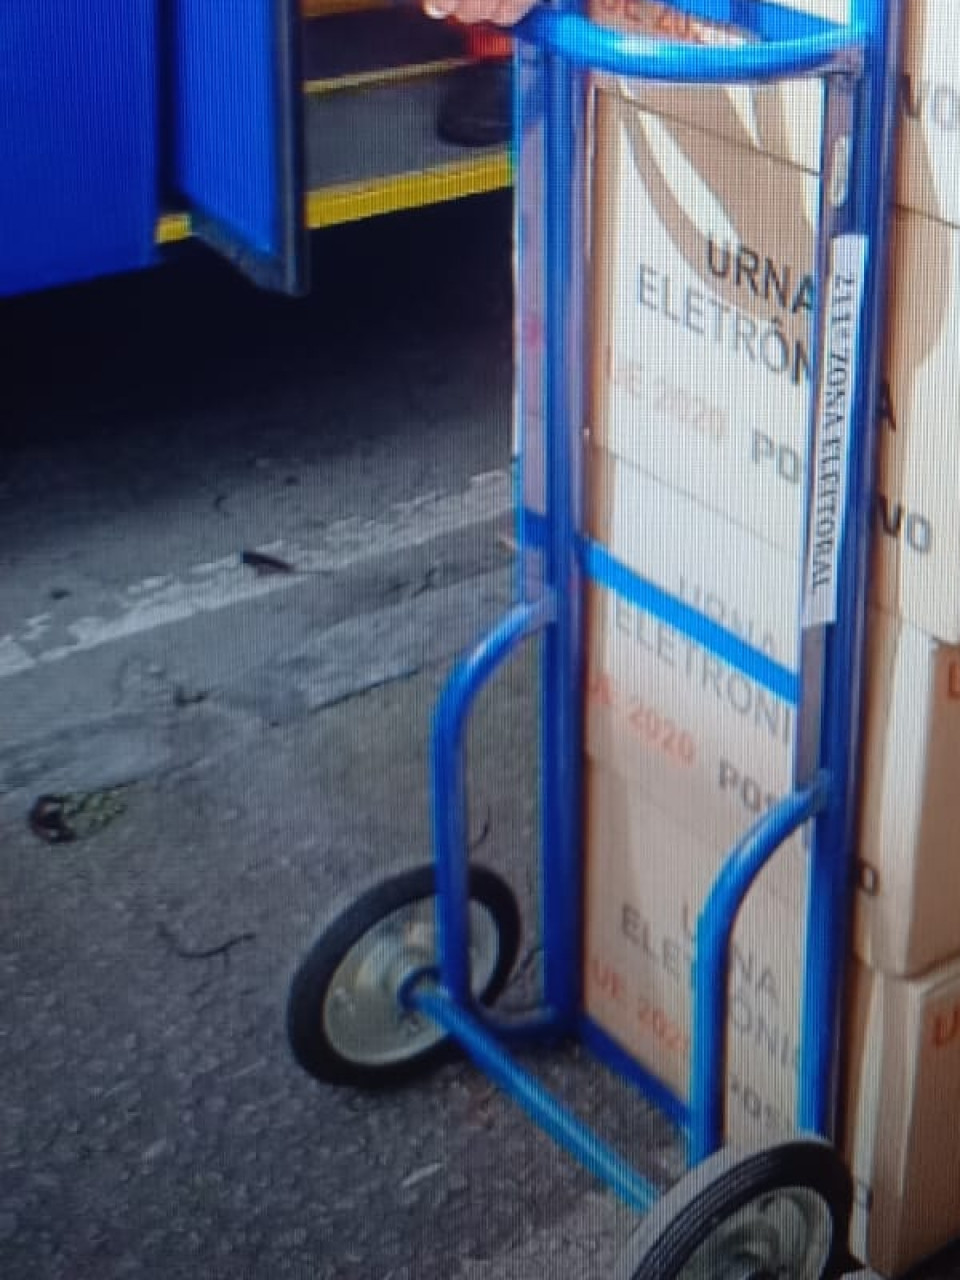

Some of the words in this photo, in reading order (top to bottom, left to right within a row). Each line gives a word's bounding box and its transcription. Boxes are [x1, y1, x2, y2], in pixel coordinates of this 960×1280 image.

[706, 237, 817, 314] URNA
[639, 263, 814, 387] ELETRÔN
[822, 346, 852, 431] ZONA
